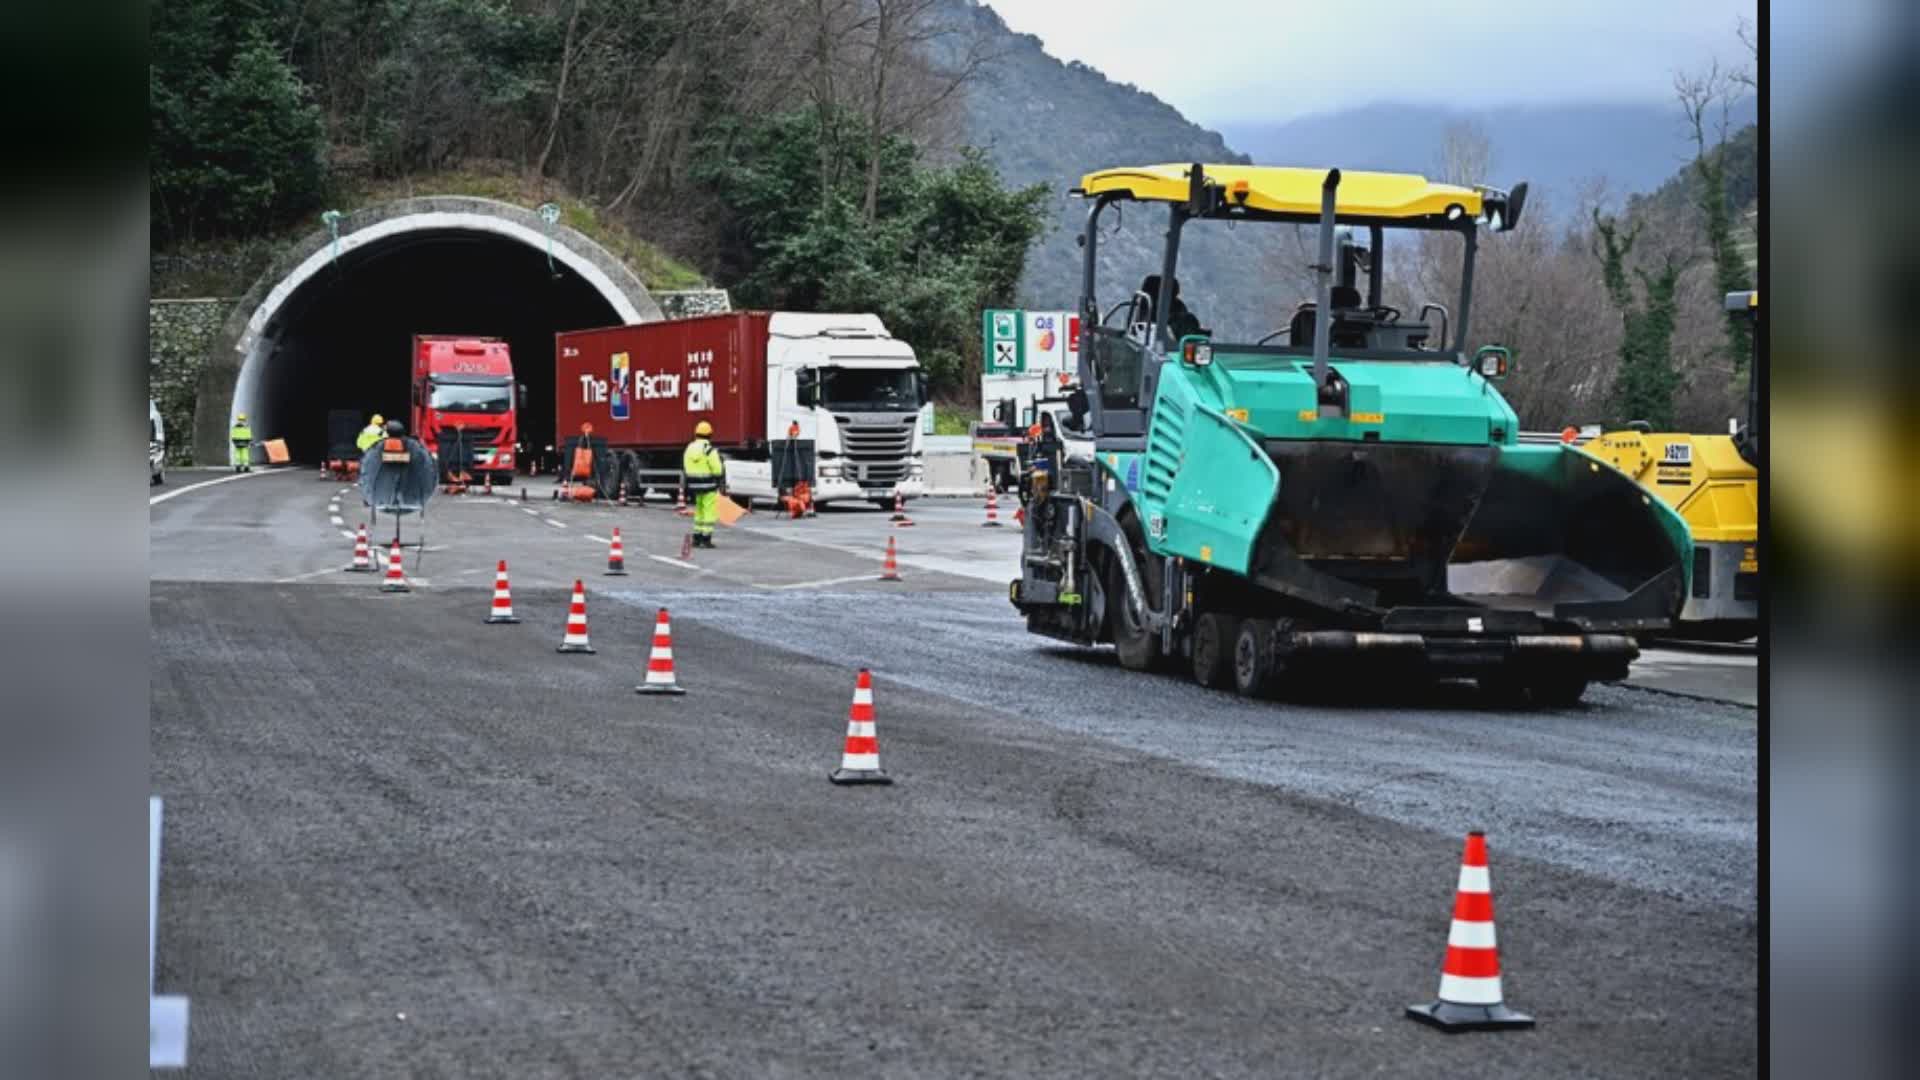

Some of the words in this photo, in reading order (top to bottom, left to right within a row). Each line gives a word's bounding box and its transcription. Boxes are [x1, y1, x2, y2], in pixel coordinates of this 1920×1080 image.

[1035, 316, 1054, 329] Q8
[579, 374, 608, 403] The
[635, 369, 681, 400] Factor
[687, 381, 714, 411] ZIM
